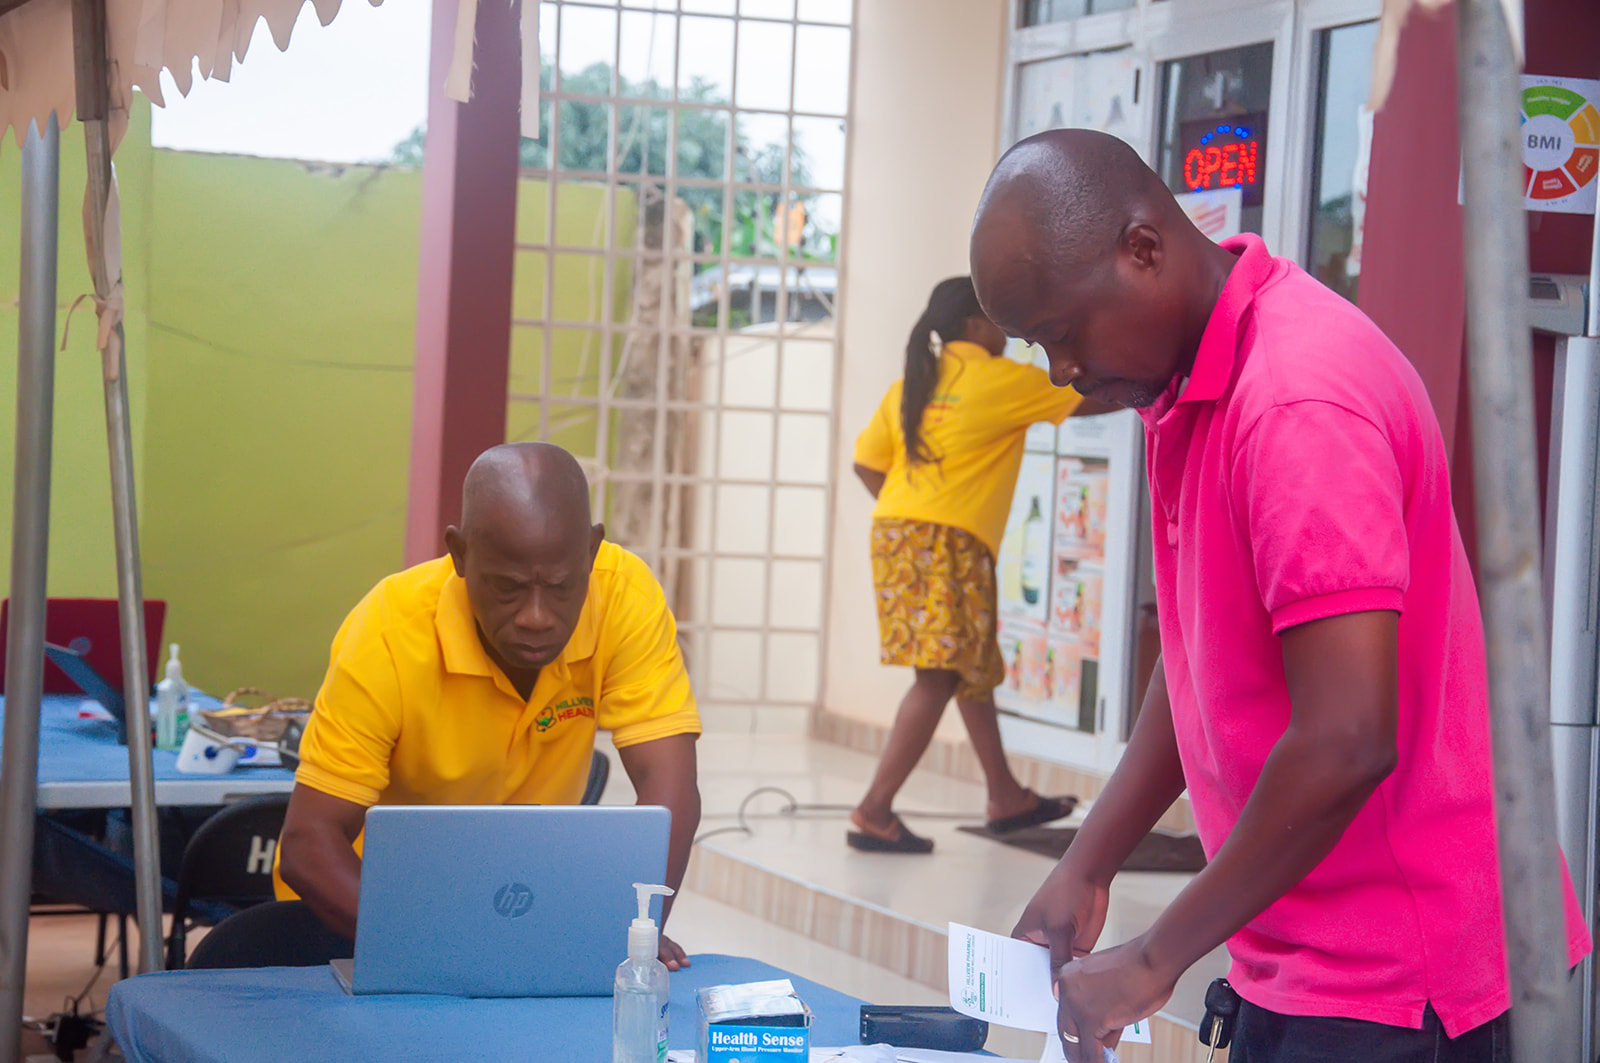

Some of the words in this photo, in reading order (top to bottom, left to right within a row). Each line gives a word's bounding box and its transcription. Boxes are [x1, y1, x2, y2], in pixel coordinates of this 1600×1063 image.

[1528, 134, 1562, 151] BMI
[1184, 141, 1257, 189] OPEN
[555, 696, 595, 712] HILLVIE
[557, 706, 596, 722] HEALT
[496, 883, 531, 918] hp
[712, 1031, 758, 1046] Health
[762, 1032, 804, 1047] Sense
